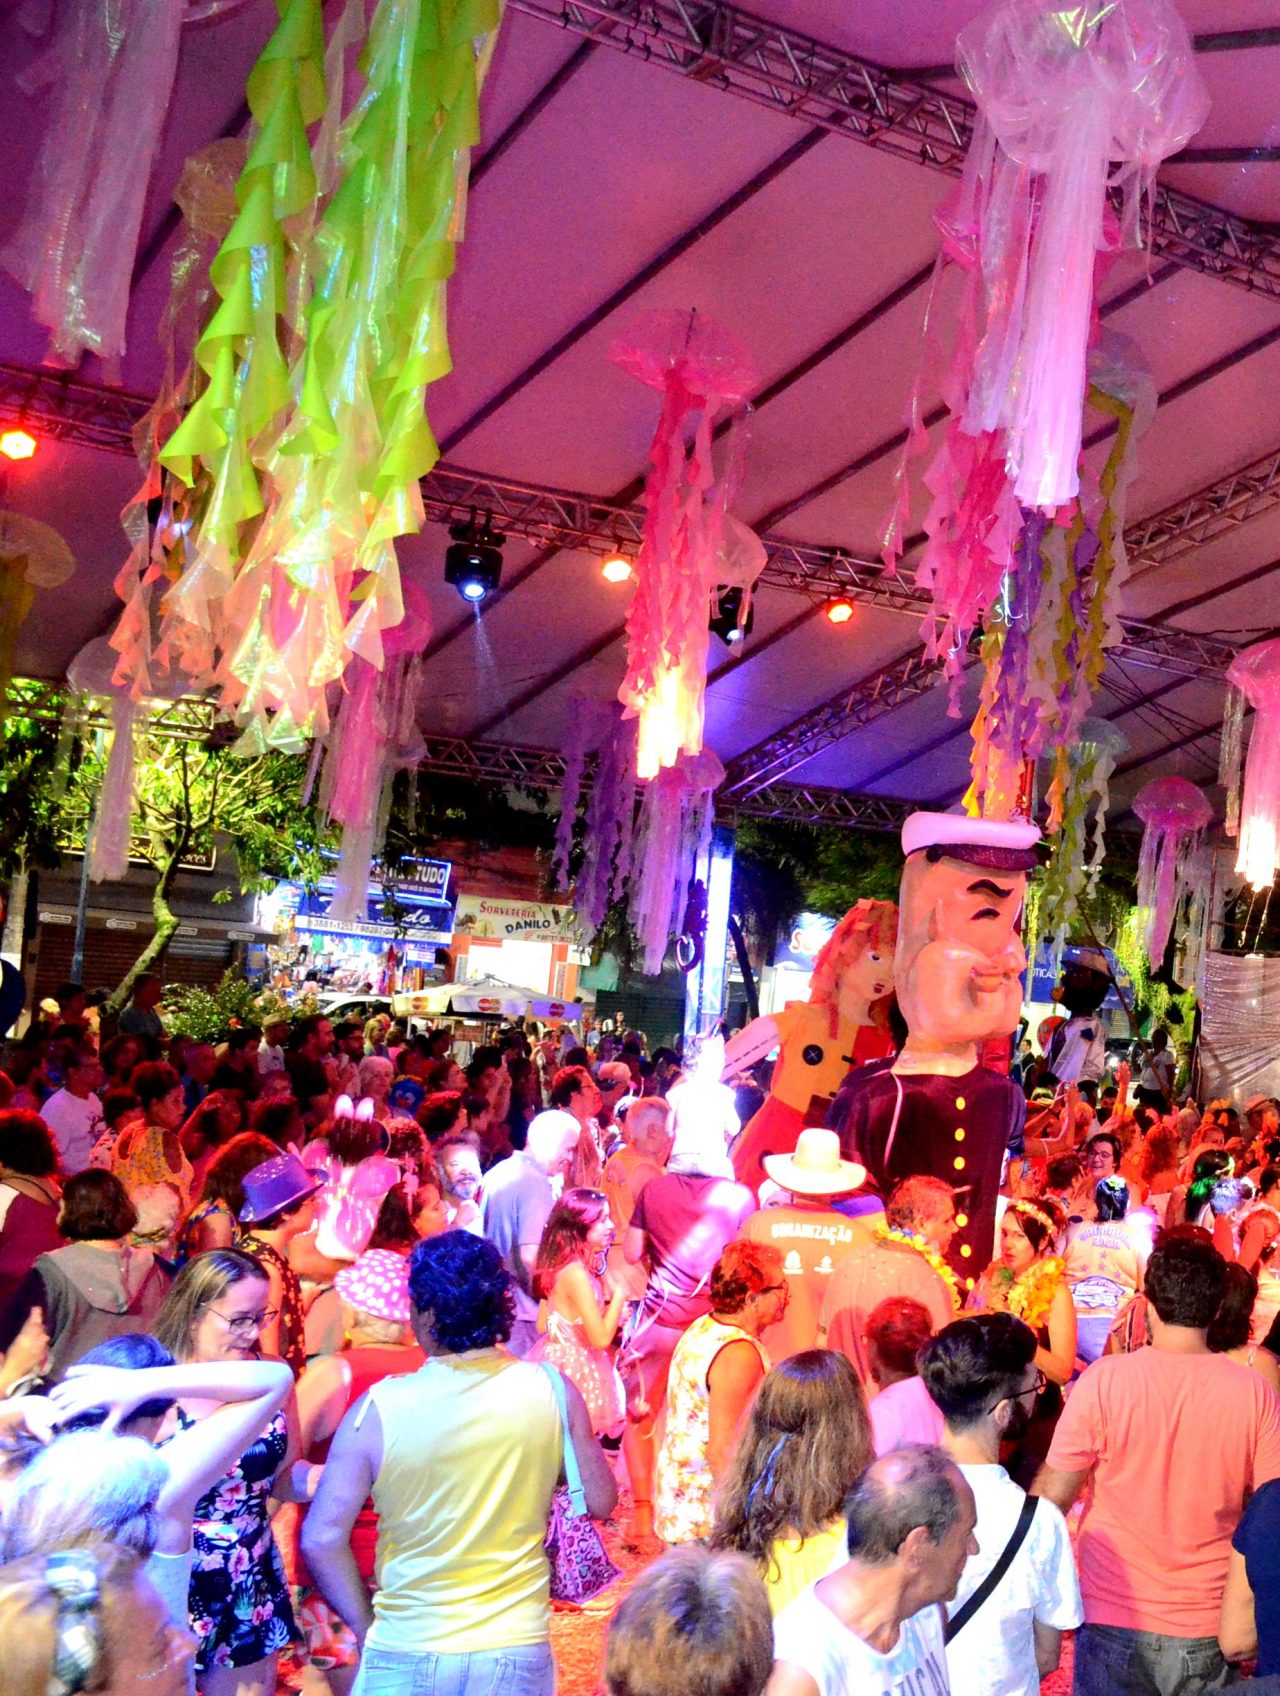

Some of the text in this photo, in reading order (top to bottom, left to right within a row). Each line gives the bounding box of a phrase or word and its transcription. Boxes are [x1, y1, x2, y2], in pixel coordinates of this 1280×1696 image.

[416, 865, 446, 883] TUDO
[480, 901, 536, 918] SORVETERIA
[505, 919, 551, 934] DANILO
[771, 1222, 853, 1246] ORGANIZAÇÃO
